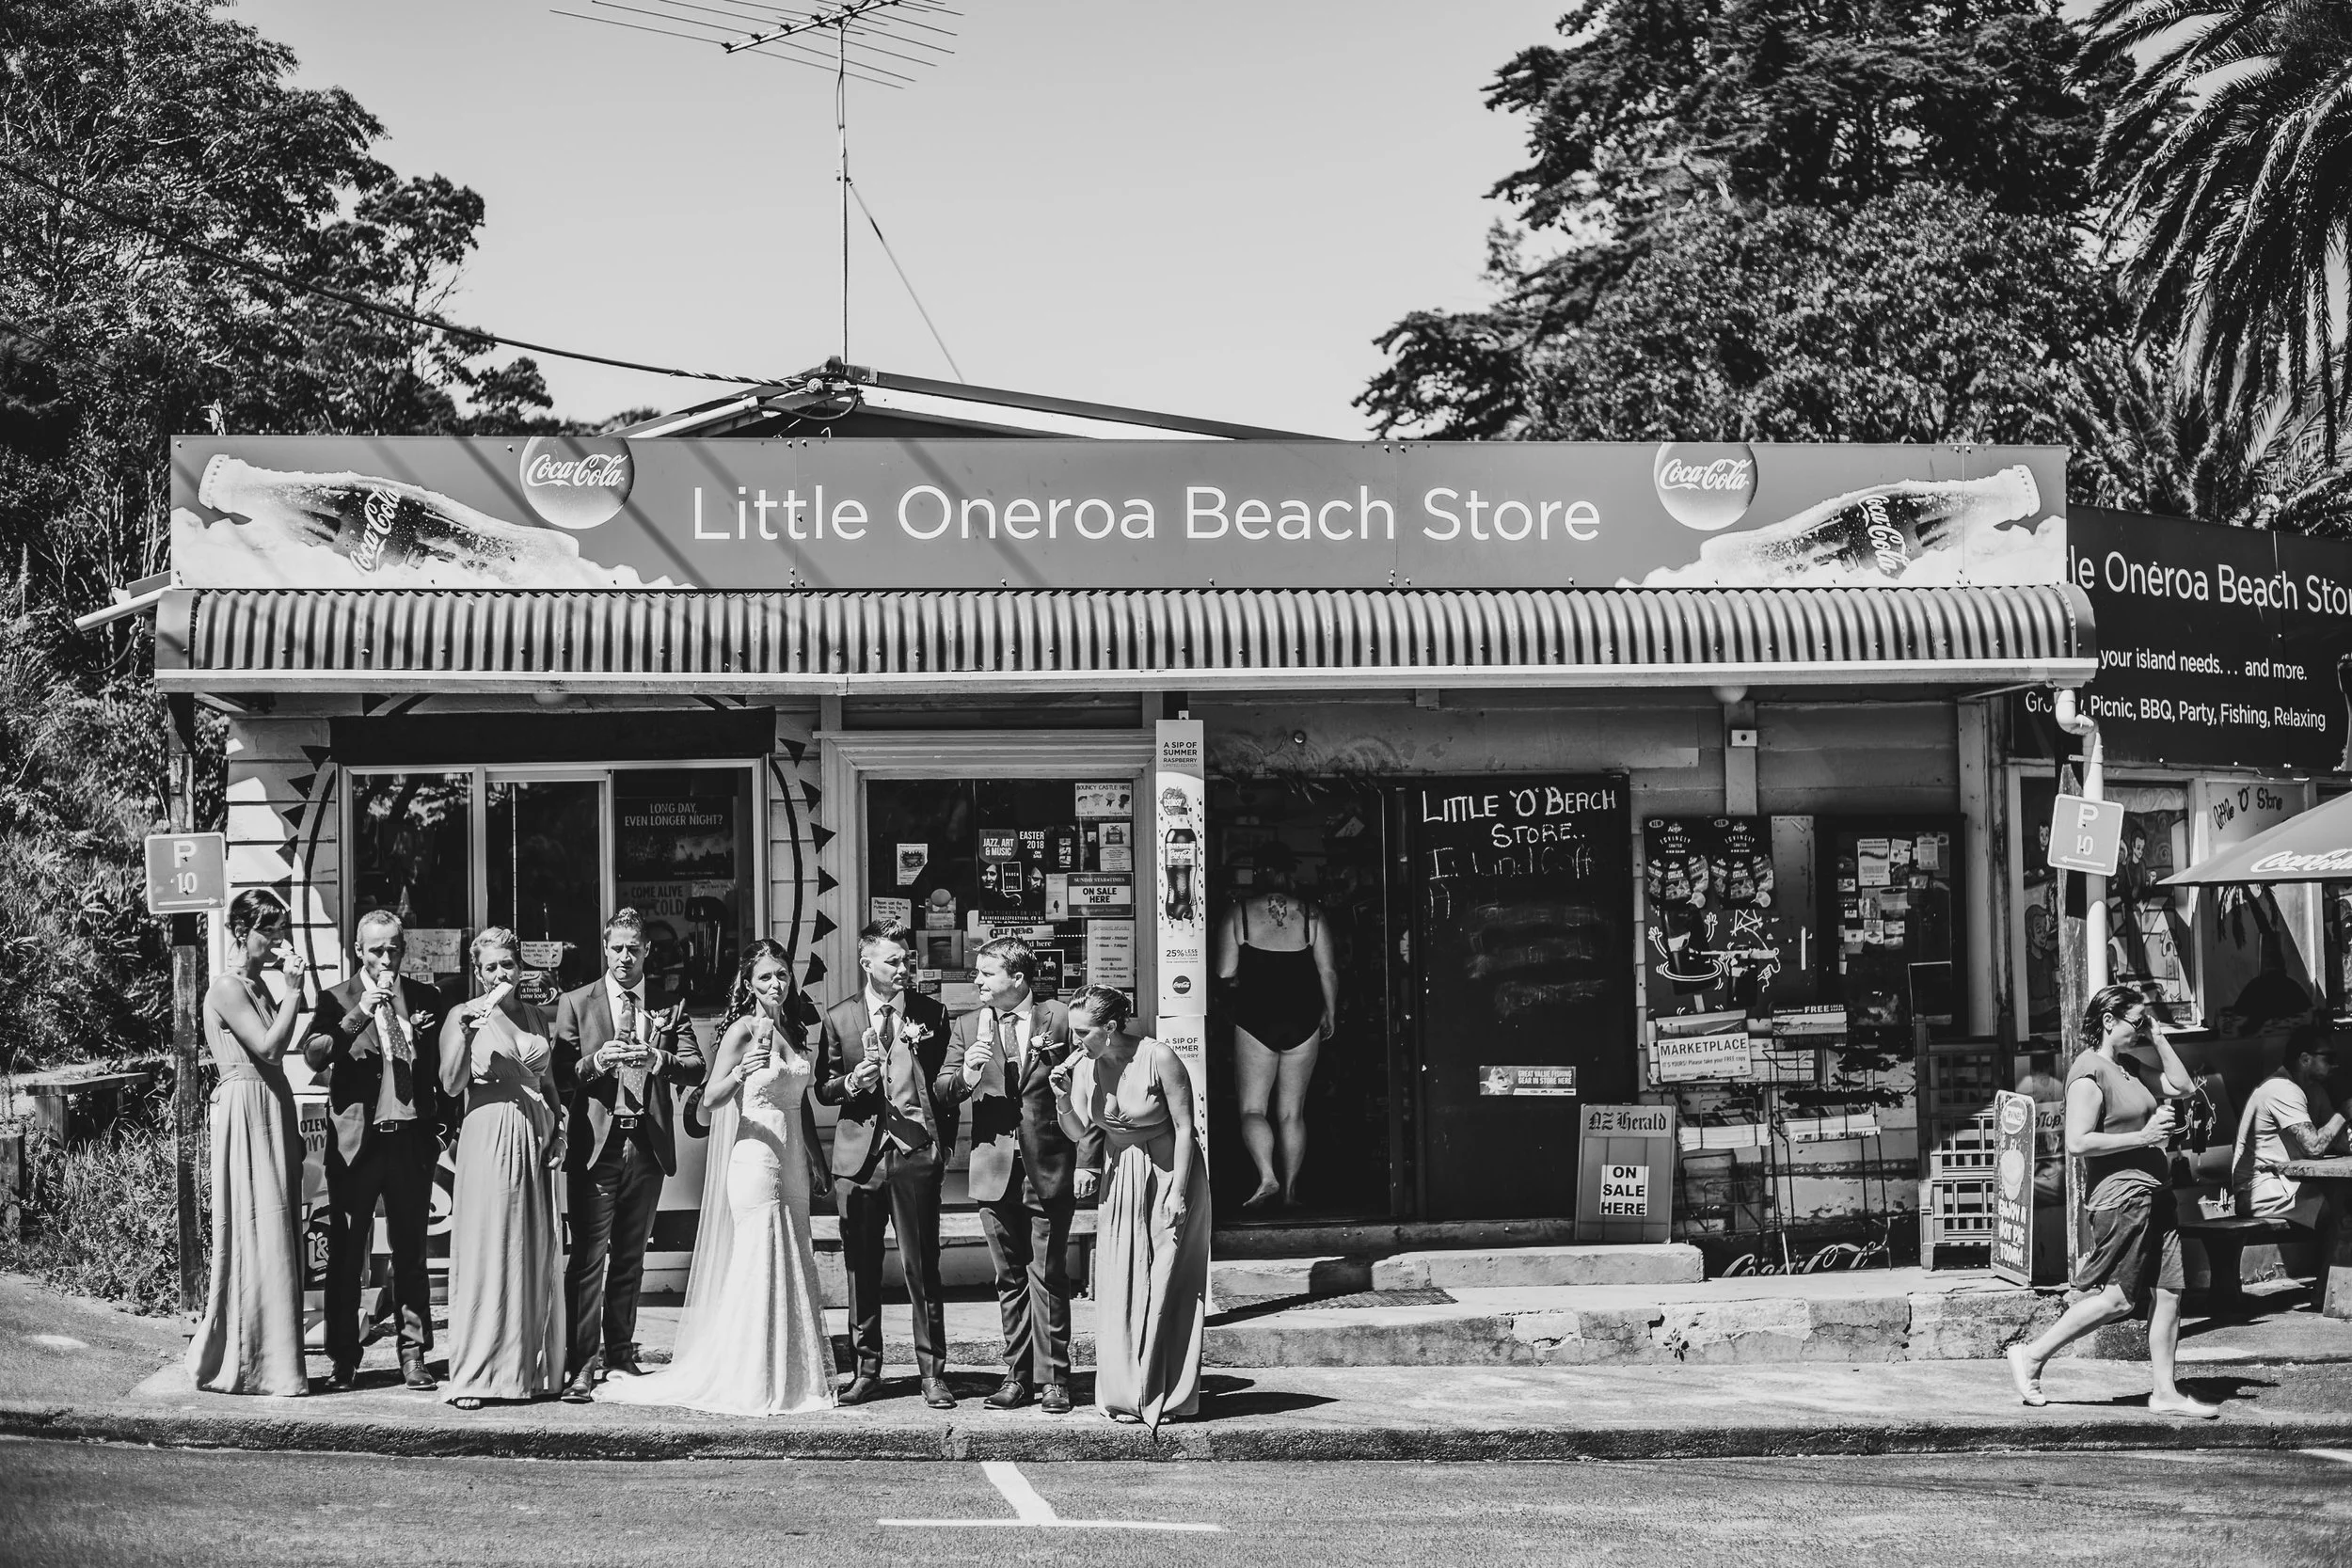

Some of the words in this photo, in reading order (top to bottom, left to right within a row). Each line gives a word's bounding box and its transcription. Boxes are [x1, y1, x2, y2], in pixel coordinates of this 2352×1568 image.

[526, 453, 628, 487] Coca-Cola
[1659, 458, 1752, 490] Coca-Cola
[694, 485, 868, 540] Little
[898, 485, 1155, 540] Oneroa
[1186, 485, 1394, 540] Beach
[1422, 487, 1600, 540] Store
[2105, 550, 2209, 601] Oneroa
[2218, 563, 2298, 610] Beach
[2101, 648, 2132, 670] your
[2136, 647, 2176, 671] island
[2245, 658, 2269, 677] and
[2273, 661, 2308, 680] more.
[2090, 695, 2137, 721] Picnic,
[2140, 698, 2176, 722] BBQ,
[2179, 701, 2217, 725] Party,
[2220, 704, 2271, 728] Fishing,
[2274, 706, 2326, 732] Relaxing
[650, 803, 675, 814] LONG
[677, 802, 697, 814] DAY,
[1545, 786, 1617, 816] BEACH
[625, 816, 648, 826] EVEN
[650, 815, 686, 826] LONGER
[690, 815, 723, 825] NIGHT?
[2077, 803, 2099, 829] P
[1001, 838, 1014, 847] ART
[1019, 831, 1044, 840] EASTER
[985, 847, 991, 856] &
[991, 847, 1012, 856] MUSIC
[1026, 840, 1044, 849] 2018
[2075, 835, 2094, 856] 10
[173, 840, 197, 868] P
[176, 871, 198, 894] 10
[631, 885, 656, 898] COME
[656, 885, 683, 897] ALIVE
[989, 927, 1009, 939] GULF
[1010, 927, 1034, 937] NEWS
[1166, 949, 1184, 958] 25%
[1804, 1006, 1830, 1014] FREE
[1661, 1038, 1747, 1056] MARKETPLACE
[1518, 1069, 1534, 1078] GREAT
[1534, 1069, 1551, 1078] VALUE
[1550, 1069, 1572, 1078] FISHING
[300, 1117, 327, 1133] OZEN
[1587, 1110, 1615, 1131] NZ
[1616, 1111, 1667, 1132] Herald
[1613, 1166, 1638, 1179] ON
[1602, 1184, 1645, 1196] SALE
[1600, 1202, 1646, 1215] HERE
